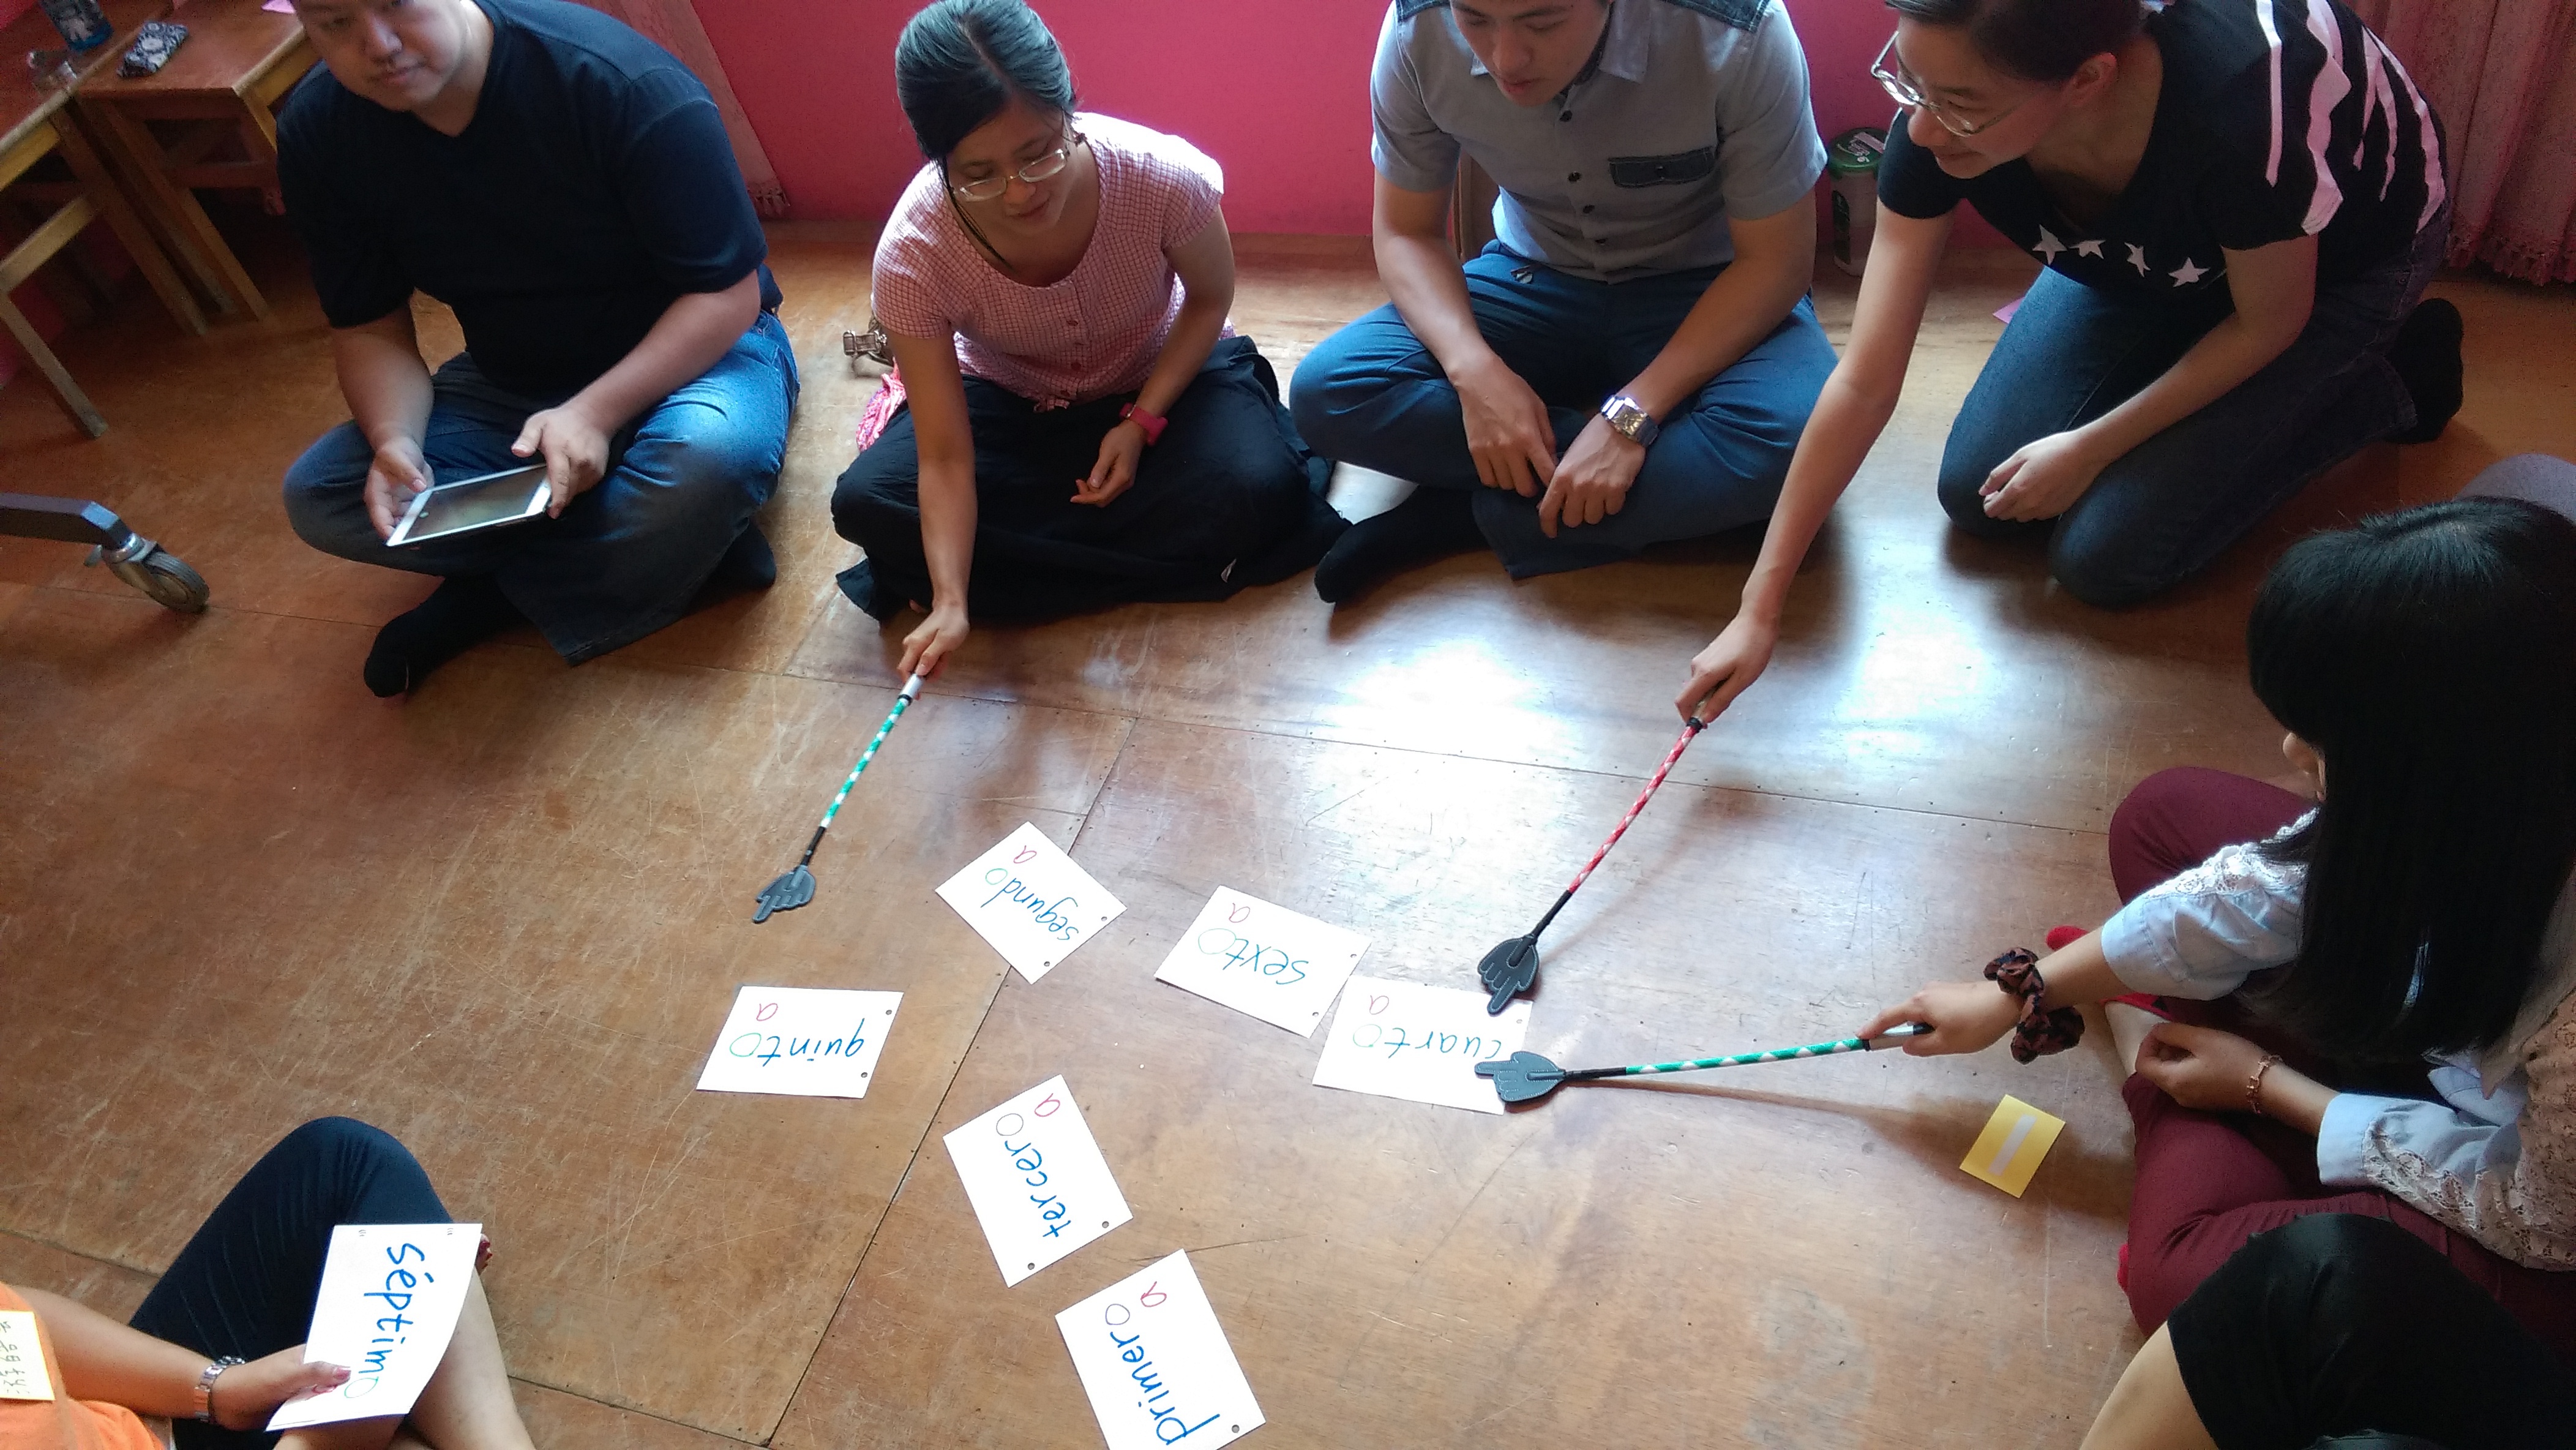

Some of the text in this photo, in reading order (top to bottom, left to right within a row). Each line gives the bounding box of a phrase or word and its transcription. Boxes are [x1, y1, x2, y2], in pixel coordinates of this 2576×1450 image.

[981, 868, 1079, 941] segundo
[1198, 928, 1309, 985] sexto
[729, 1017, 865, 1067] quinto
[1353, 1023, 1502, 1059] cuarto
[996, 1113, 1071, 1238] tercero
[344, 1242, 434, 1399] séptimo
[1105, 1303, 1220, 1446] primero
